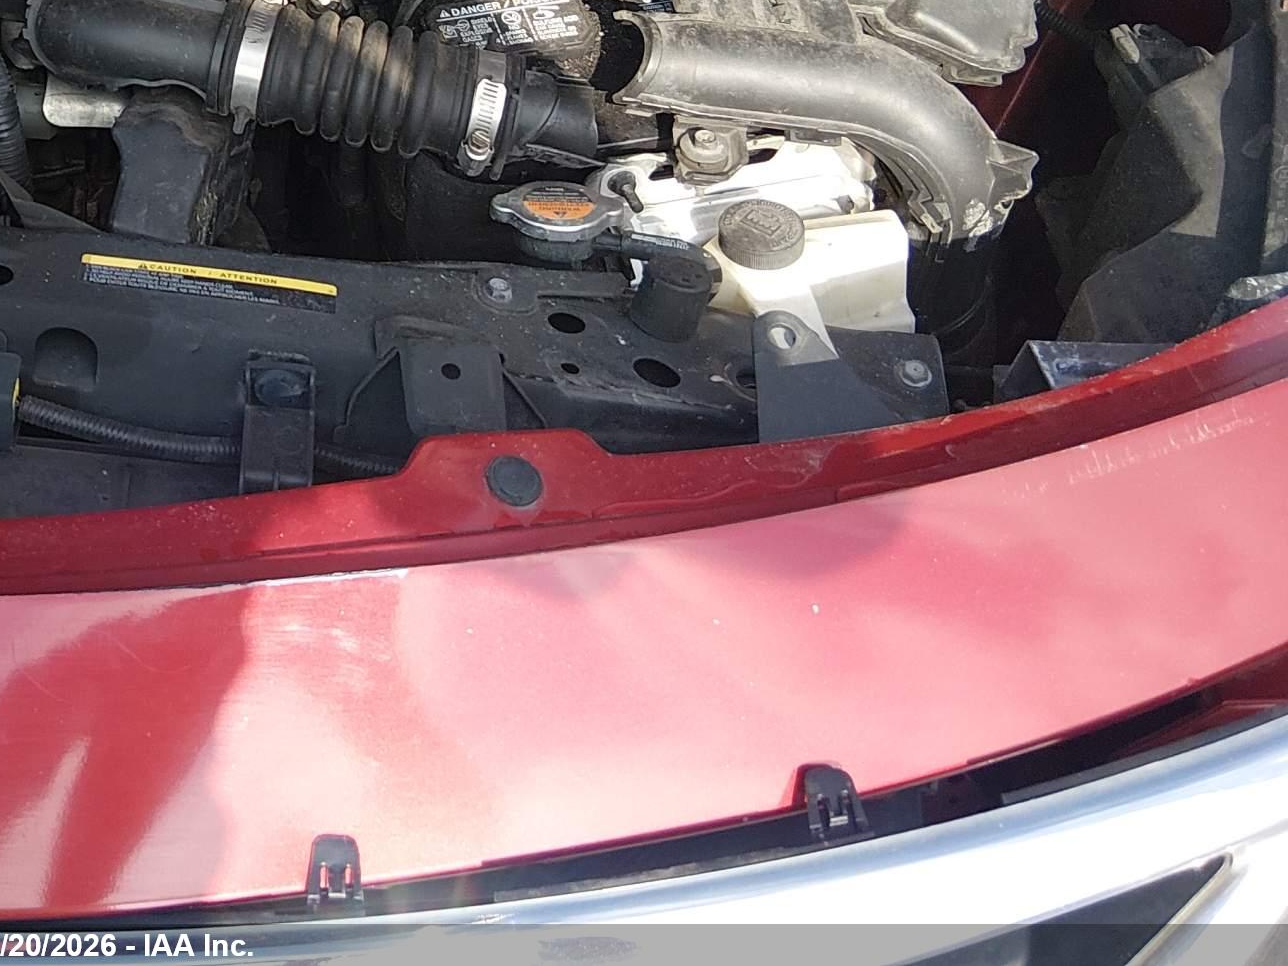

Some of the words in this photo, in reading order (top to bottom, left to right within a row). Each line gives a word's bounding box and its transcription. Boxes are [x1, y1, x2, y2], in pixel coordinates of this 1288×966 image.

[451, 2, 501, 16] DANGER
[503, 0, 510, 8] /
[149, 264, 197, 275] CAUTION
[220, 273, 278, 285] ATTENTION
